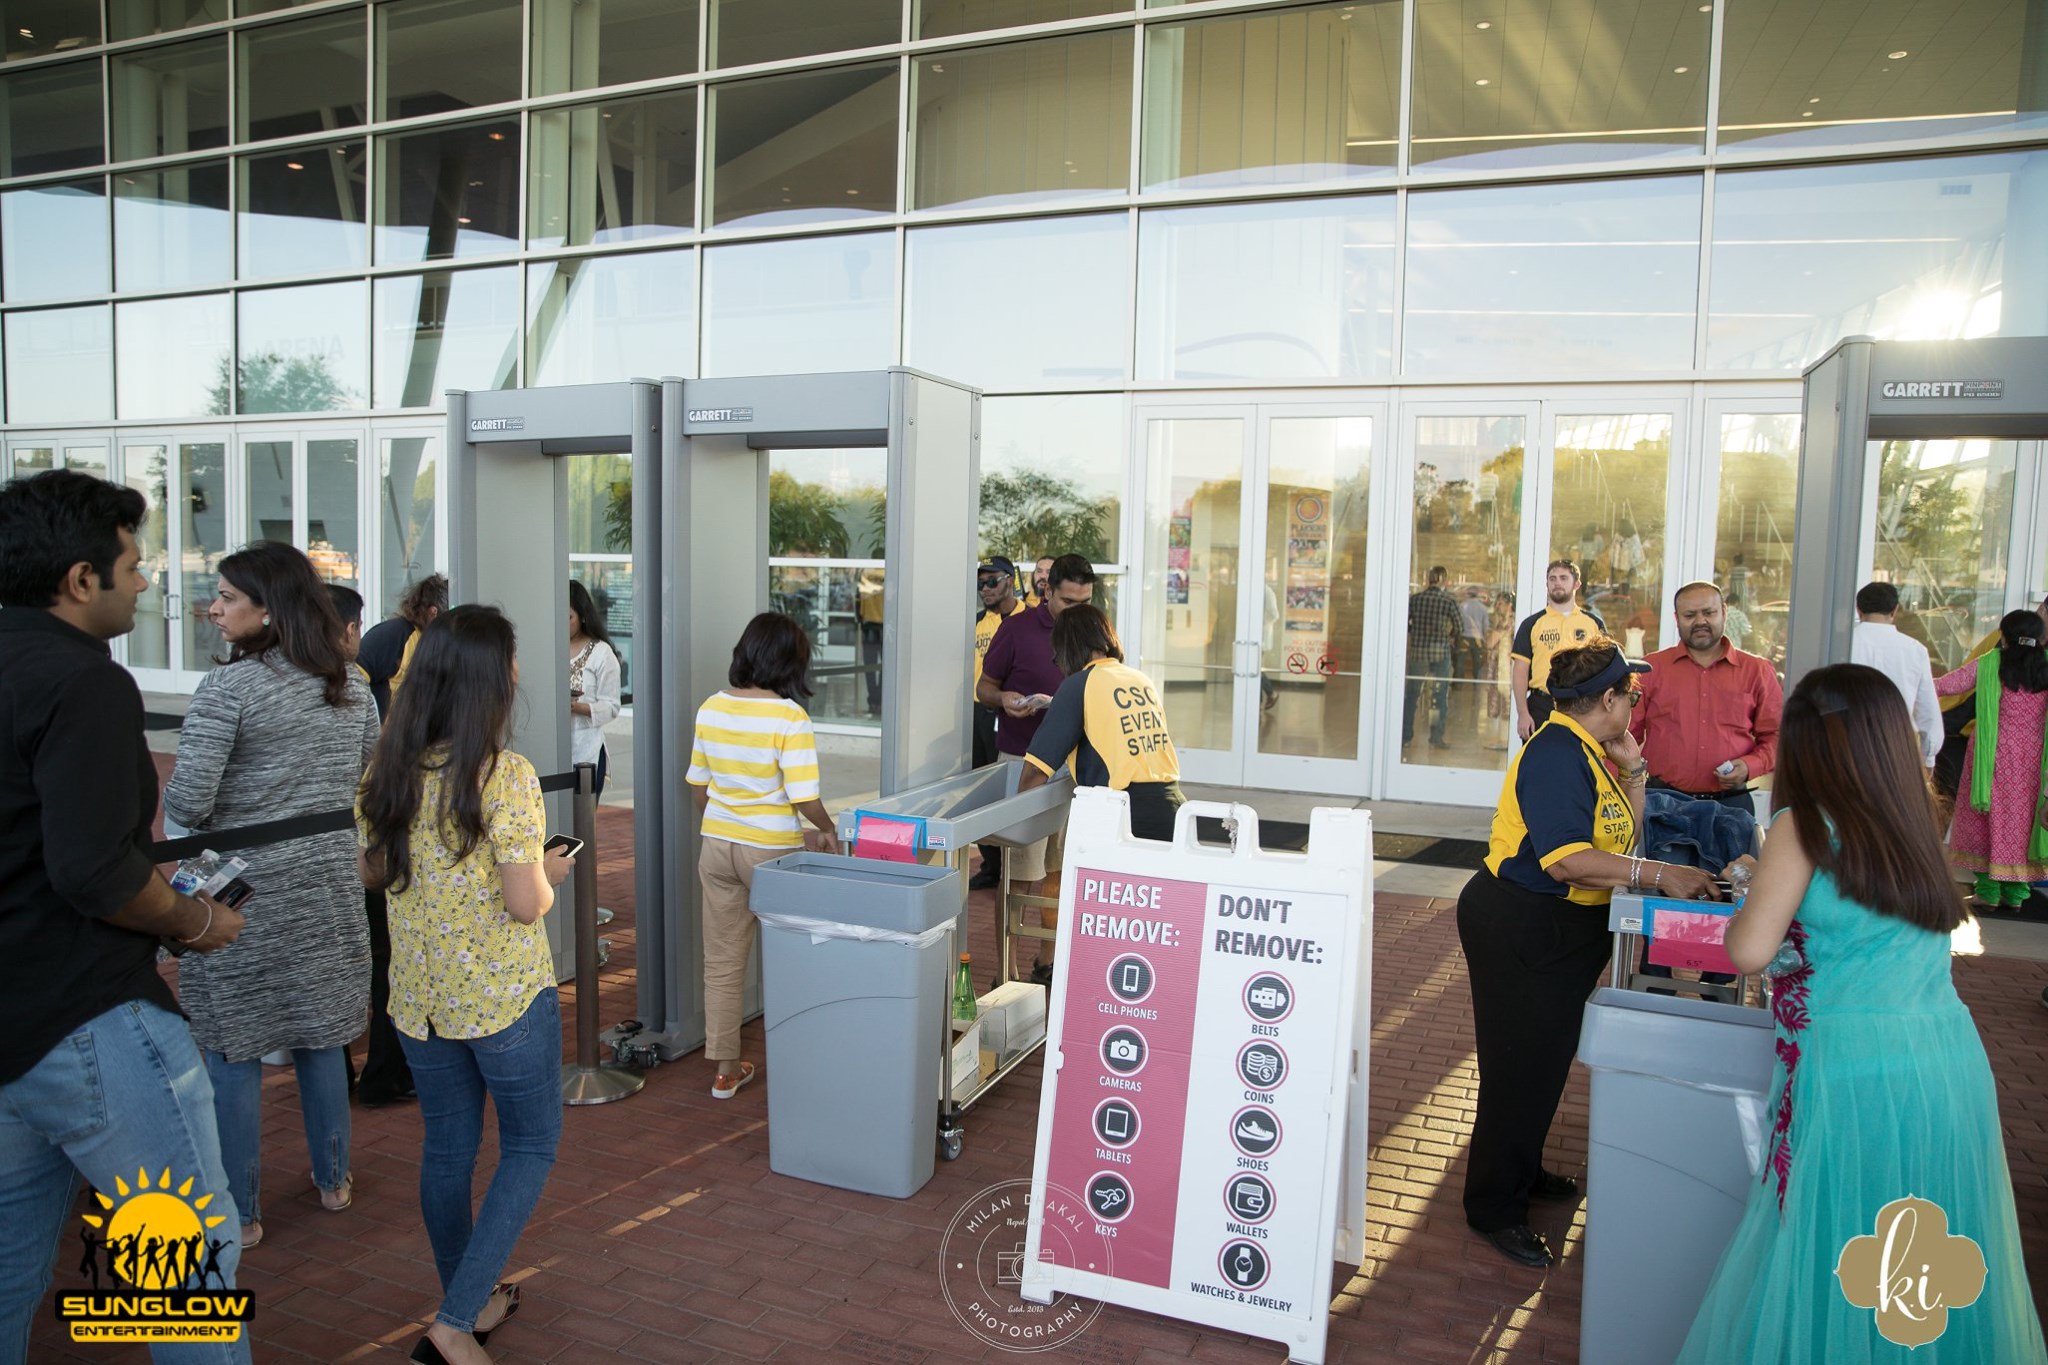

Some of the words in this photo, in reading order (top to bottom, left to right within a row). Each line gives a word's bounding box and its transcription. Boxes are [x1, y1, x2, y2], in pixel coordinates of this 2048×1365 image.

[1882, 381, 1963, 397] GARRETT
[688, 409, 731, 422] GARRETT
[471, 418, 507, 431] GARRETT
[1539, 632, 1560, 642] 4000
[1120, 710, 1162, 735] EVEN
[1127, 733, 1168, 756] STAFF
[1604, 821, 1630, 834] STAFF
[1083, 878, 1163, 910] PLEASE
[1218, 894, 1293, 924] DON'T
[1080, 912, 1181, 947] REMOVE:
[1214, 929, 1323, 965] REMOVE:
[1098, 1002, 1119, 1016] CELL
[1120, 1005, 1158, 1021] PHONES
[1251, 1024, 1279, 1037] BELTS
[1099, 1076, 1142, 1092] CAMERAS
[1243, 1090, 1275, 1105] COINS
[1095, 1148, 1132, 1164] TABLETS
[1236, 1157, 1269, 1172] SHOES
[1095, 1223, 1118, 1238] KEYS
[1226, 1221, 1269, 1239] WALLETS
[1191, 1282, 1236, 1302] WATCHES
[1238, 1292, 1245, 1302] &
[1246, 1293, 1292, 1312] JEWELRY
